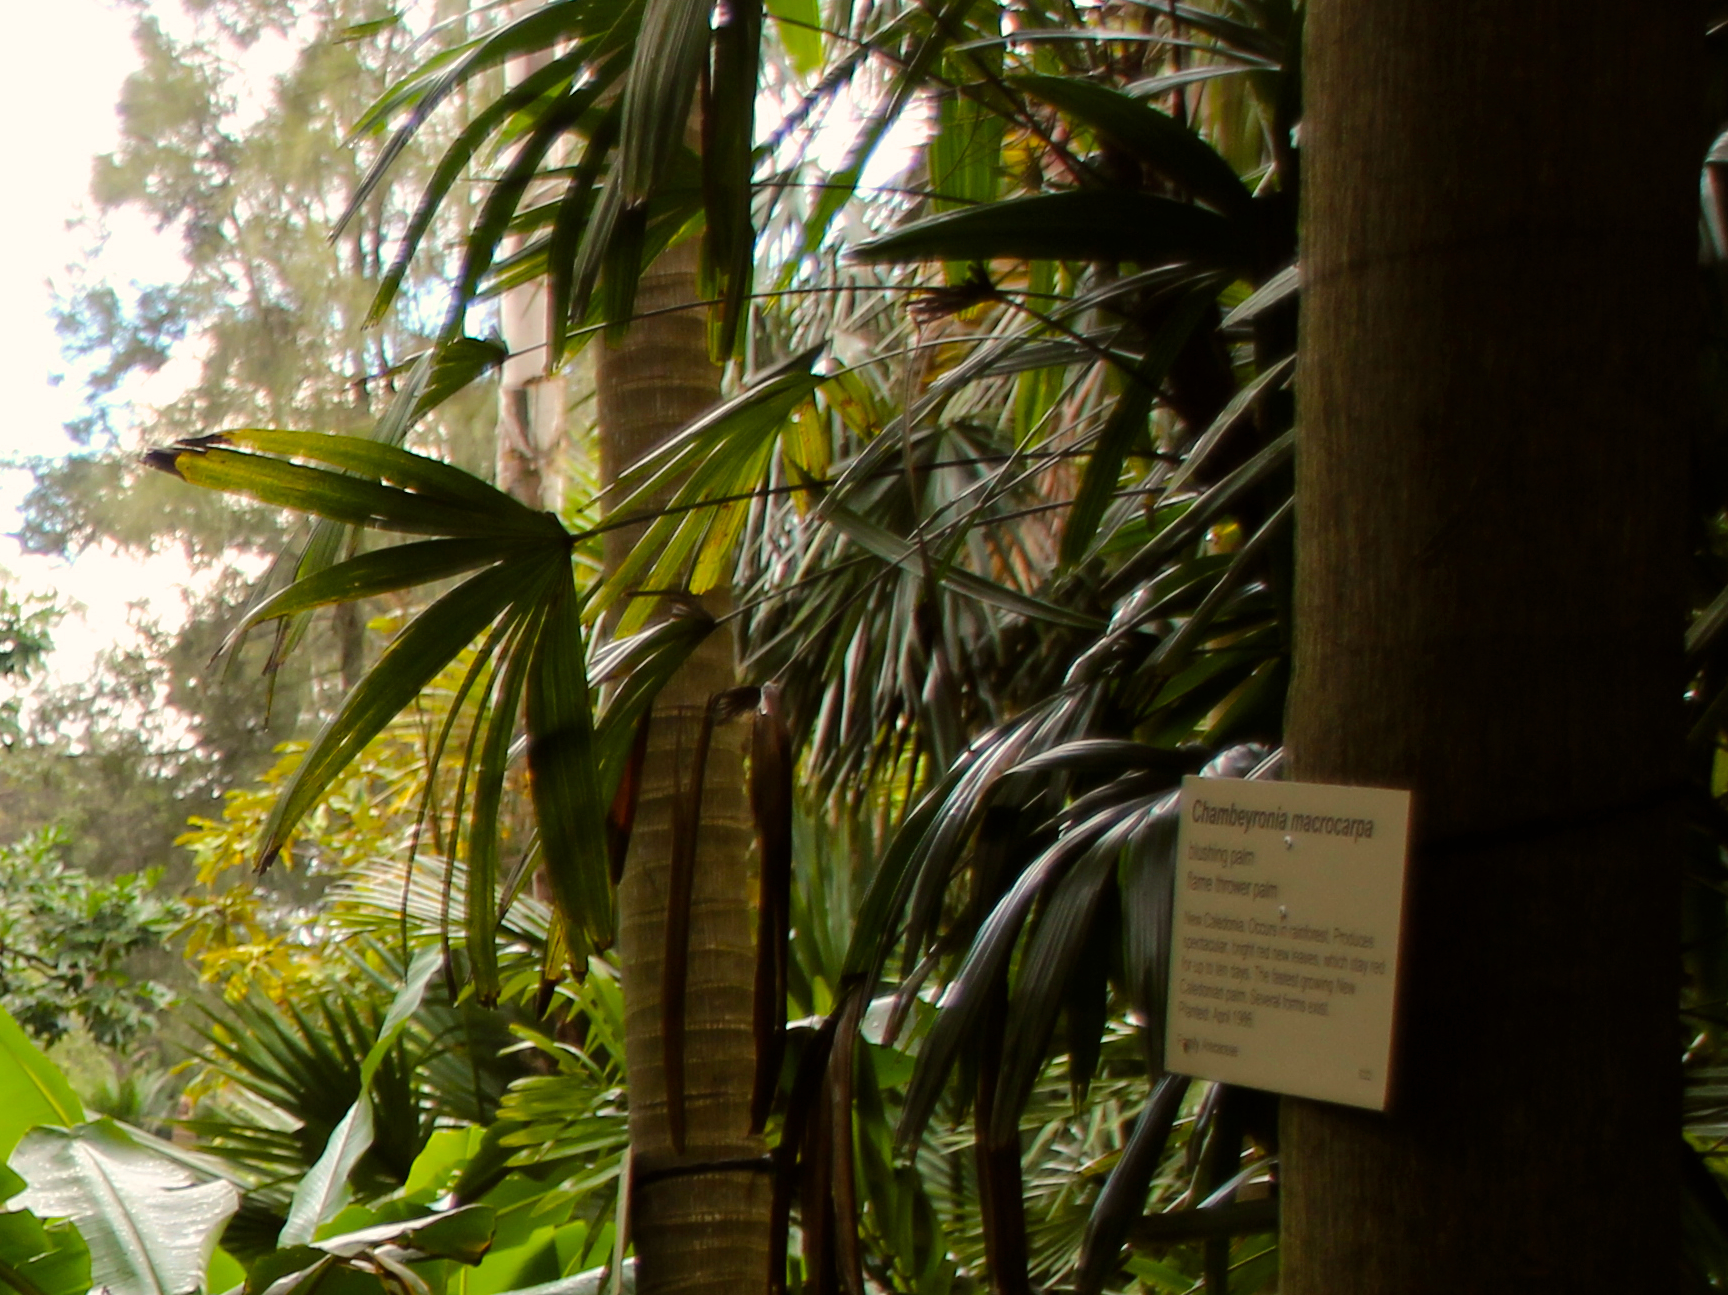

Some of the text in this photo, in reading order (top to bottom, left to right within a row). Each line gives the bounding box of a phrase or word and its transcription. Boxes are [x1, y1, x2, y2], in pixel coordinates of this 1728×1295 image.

[1192, 799, 1374, 843] Chambeyronia macrocarpa
[1189, 841, 1254, 868] blushing palm
[1187, 871, 1277, 901] flame thrower palm
[1249, 918, 1276, 936] Occurs
[1333, 928, 1375, 948] Produces
